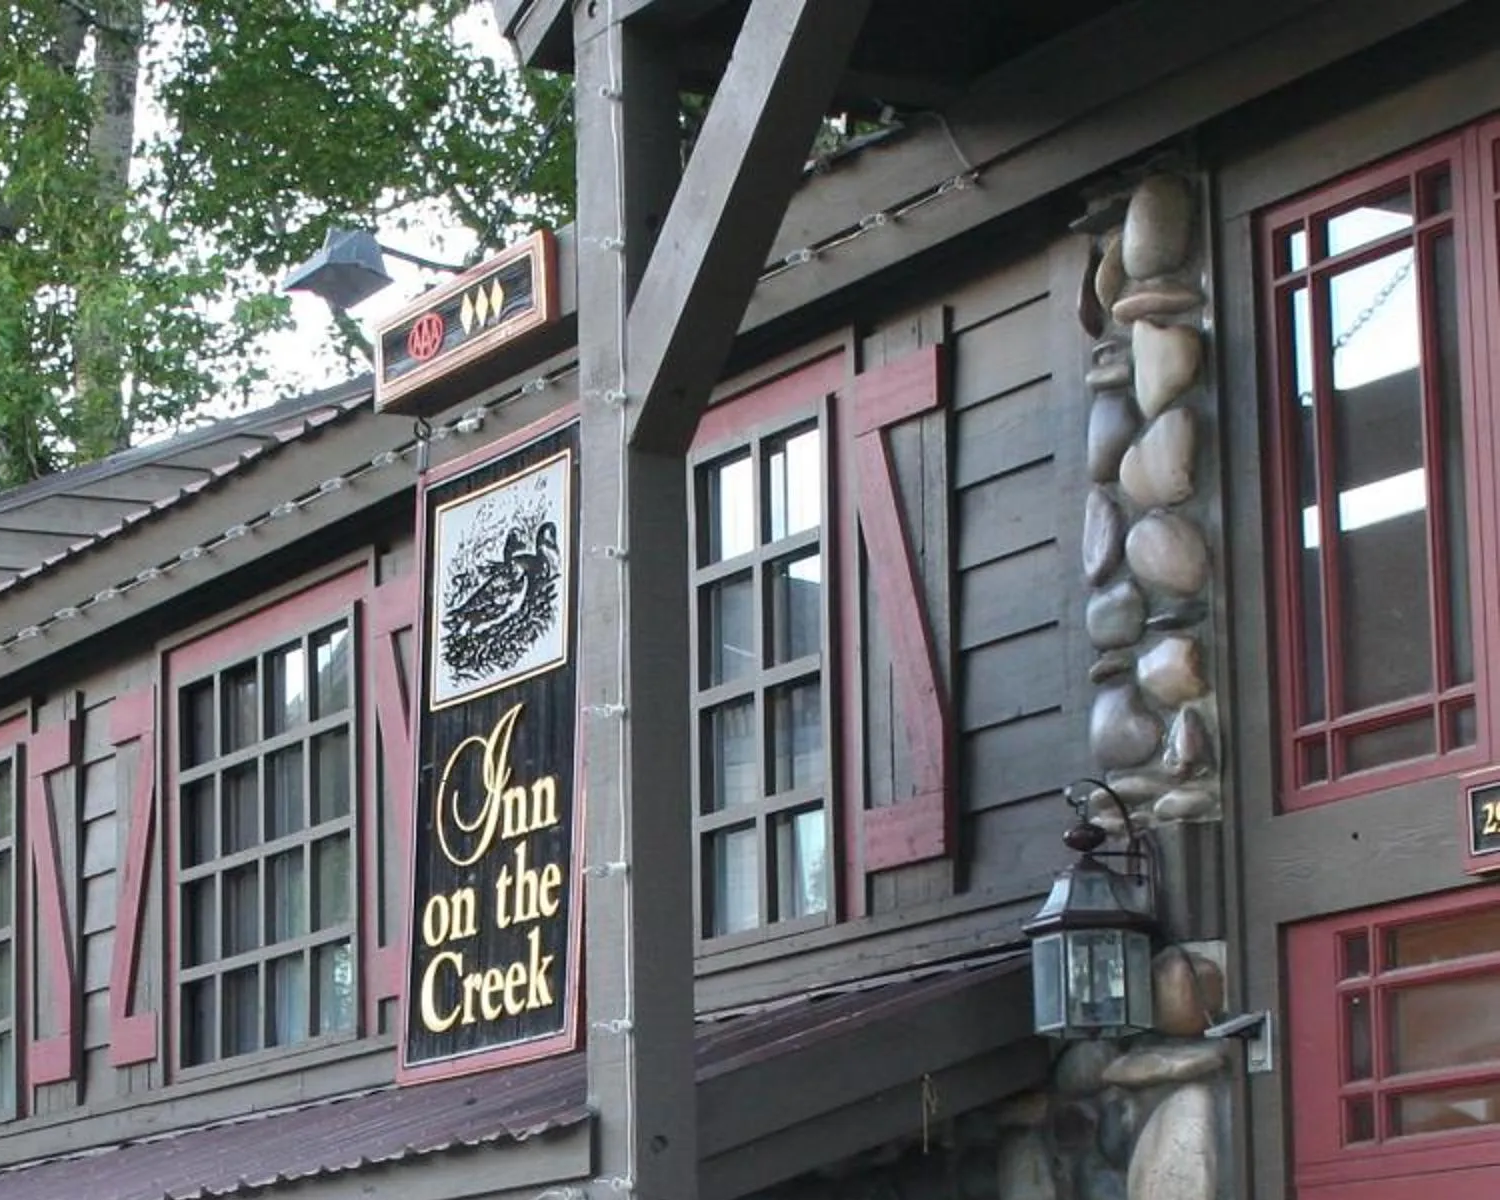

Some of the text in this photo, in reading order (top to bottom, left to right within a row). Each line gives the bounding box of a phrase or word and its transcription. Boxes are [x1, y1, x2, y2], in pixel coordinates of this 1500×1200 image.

[409, 313, 443, 361] AAA
[437, 703, 559, 866] Inn
[1481, 801, 1500, 835] 2
[423, 840, 561, 947] on the
[421, 926, 554, 1033] Creek
